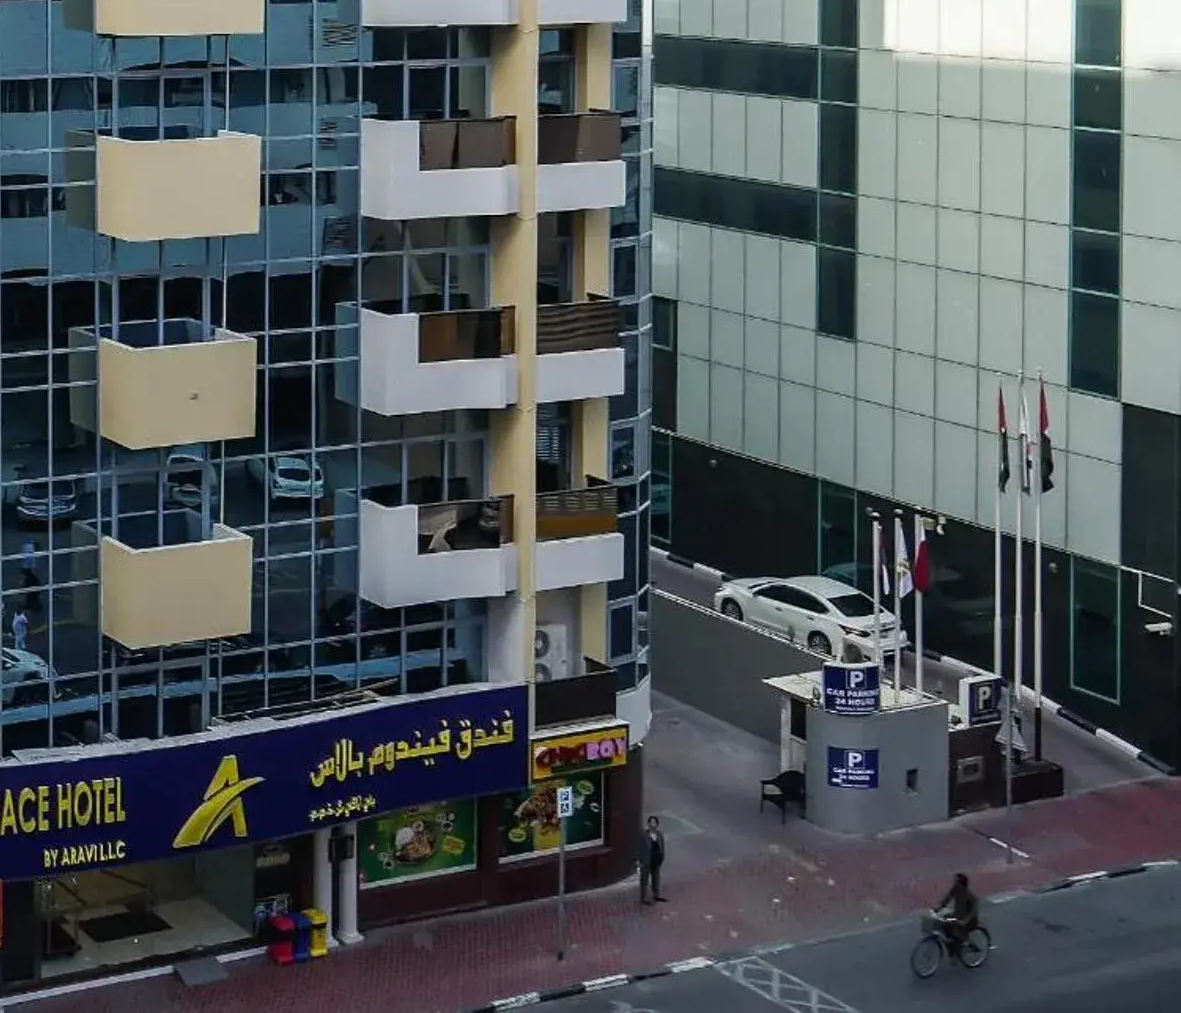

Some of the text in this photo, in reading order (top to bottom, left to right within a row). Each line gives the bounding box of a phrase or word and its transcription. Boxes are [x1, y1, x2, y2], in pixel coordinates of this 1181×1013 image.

[850, 670, 864, 688] P
[826, 687, 845, 697] CAR
[978, 686, 991, 710] P
[310, 710, 514, 787] فندق فيندوم بالاس
[848, 752, 863, 767] P
[56, 776, 126, 830] HOTEL
[43, 848, 58, 868] BY
[60, 843, 97, 866] ARAVI
